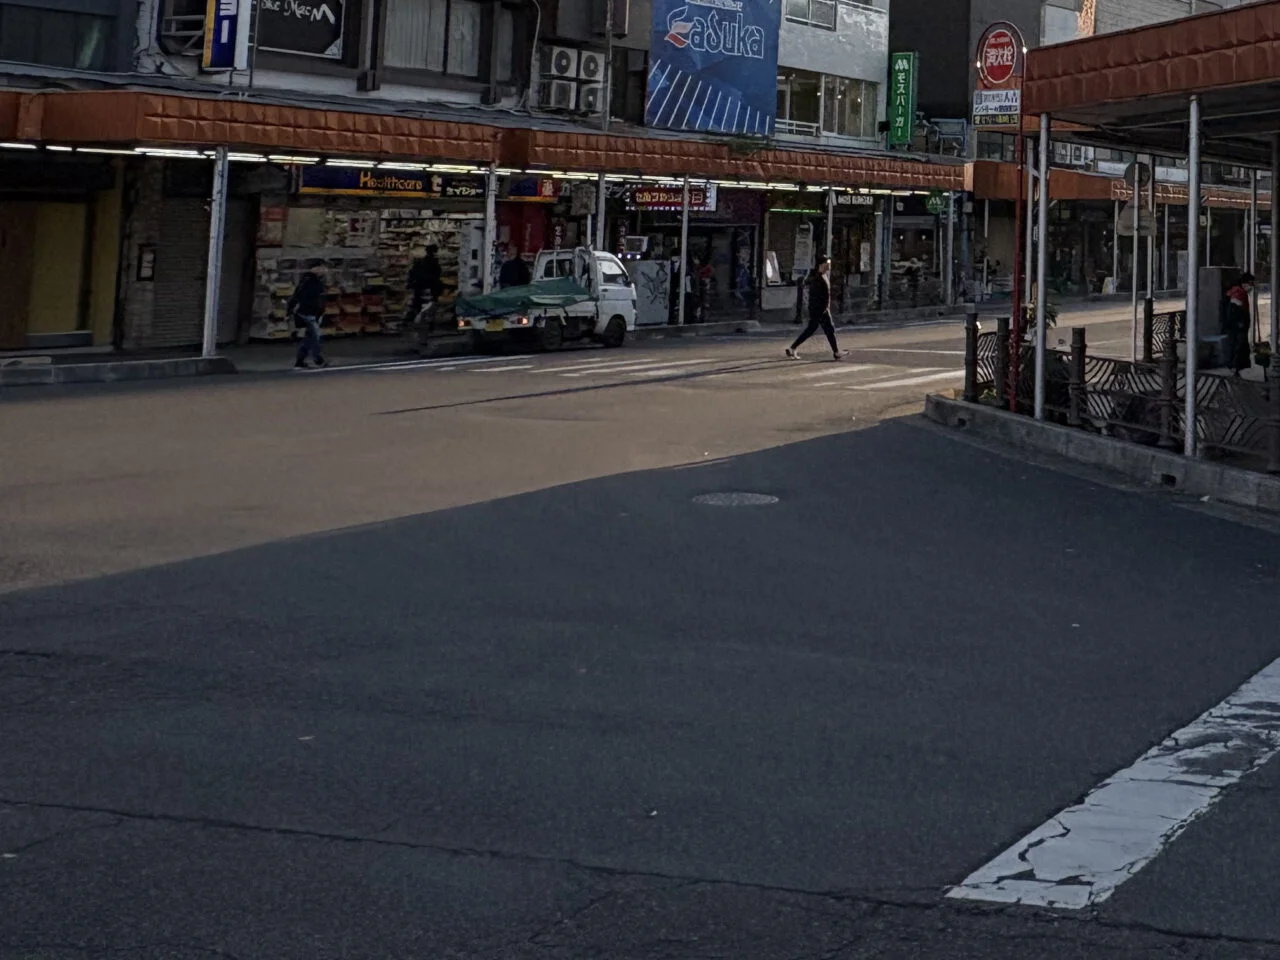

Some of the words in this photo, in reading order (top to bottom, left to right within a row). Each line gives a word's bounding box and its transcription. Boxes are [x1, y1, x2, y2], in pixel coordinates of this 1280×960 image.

[895, 72, 908, 137] モスバーガー
